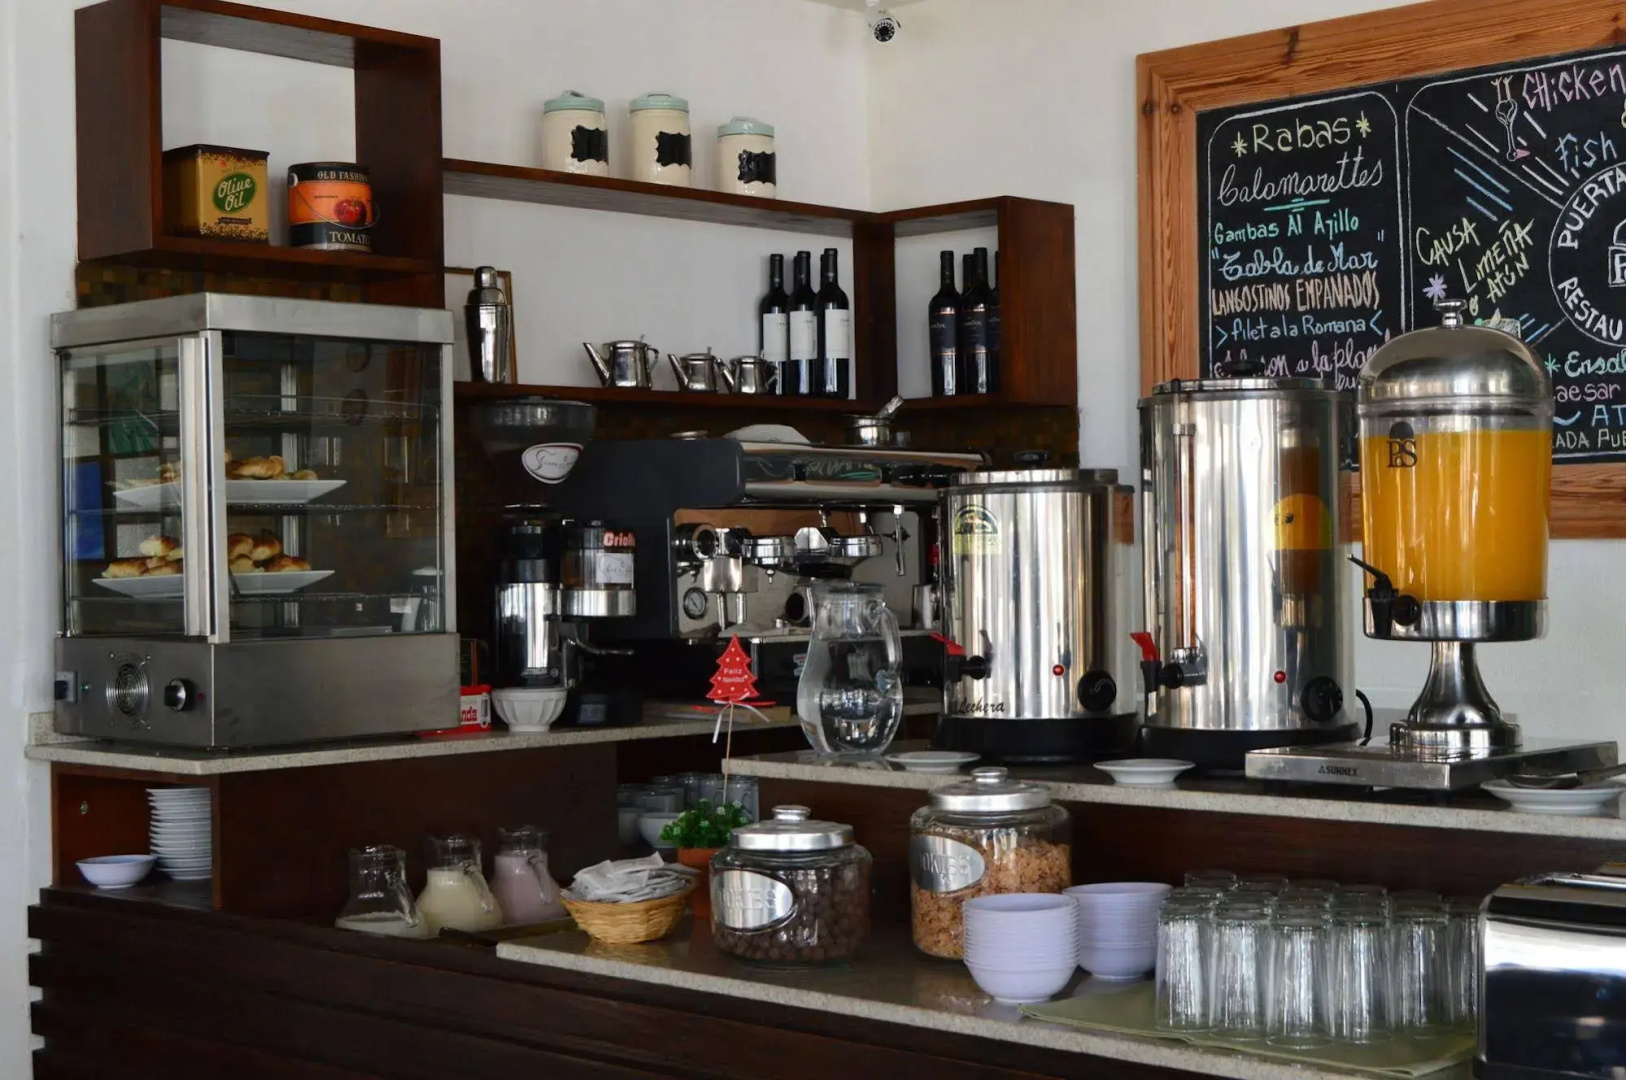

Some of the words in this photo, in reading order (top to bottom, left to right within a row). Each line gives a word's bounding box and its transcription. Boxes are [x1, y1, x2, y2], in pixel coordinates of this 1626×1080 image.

[1253, 118, 1350, 154] Rabas
[317, 170, 336, 180] OLD
[1217, 145, 1383, 206] Calamarettes
[217, 177, 253, 198] Olive
[225, 190, 245, 211] Oil
[1215, 222, 1279, 244] Gambas
[1287, 213, 1302, 236] Al
[1415, 217, 1481, 266] CAUSA
[1301, 245, 1324, 274] de
[1212, 282, 1290, 316] LANGOSTINOS
[1296, 271, 1380, 312] EMPANADOS
[1557, 276, 1623, 340] RESTAU
[1302, 314, 1366, 335] Romana
[1553, 383, 1621, 402] aesar
[1552, 430, 1590, 449] ADA
[723, 667, 743, 675] Feliz
[958, 696, 1006, 715] Lechera
[1326, 765, 1359, 777] SUNNEX
